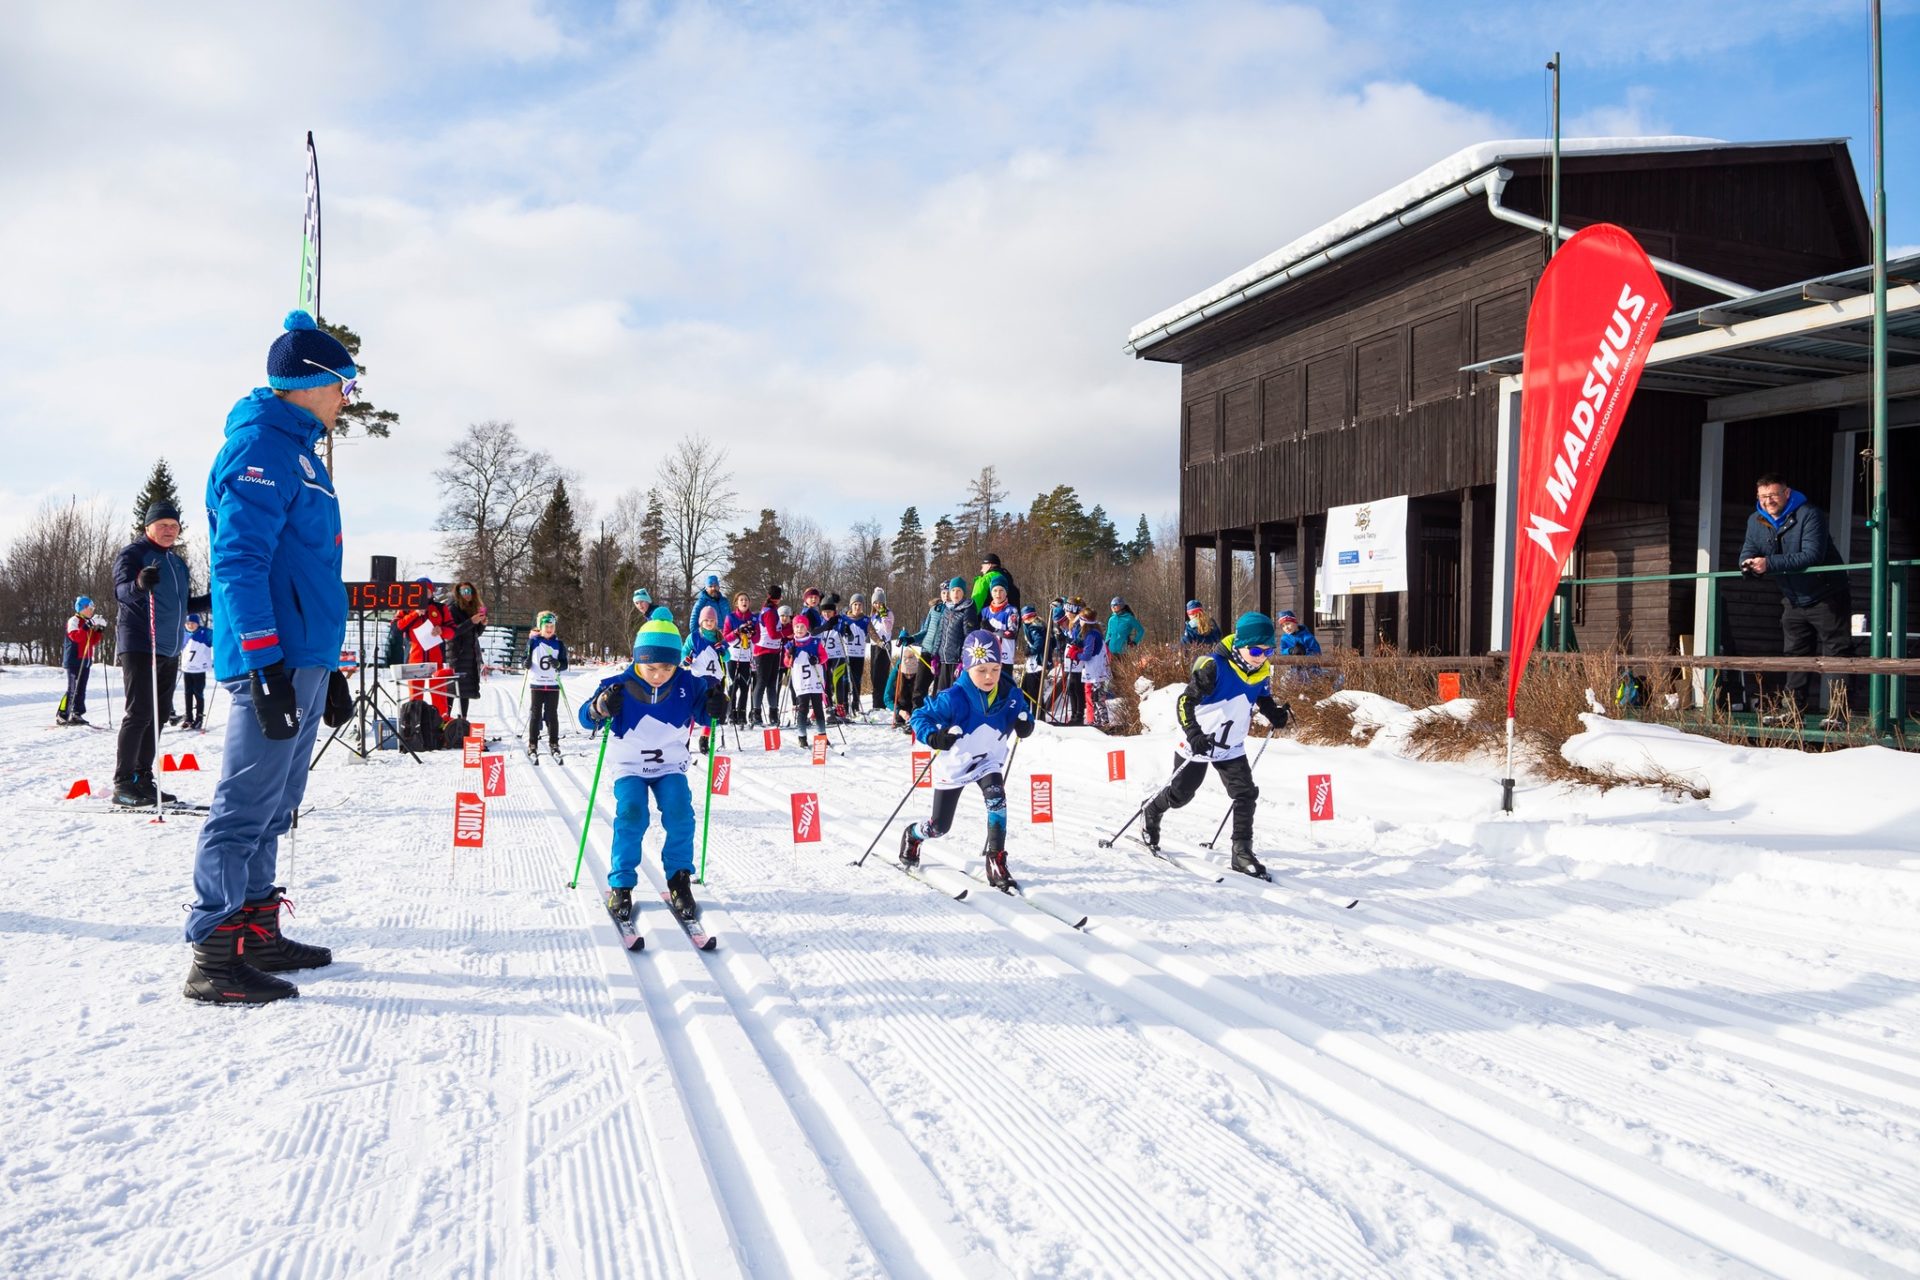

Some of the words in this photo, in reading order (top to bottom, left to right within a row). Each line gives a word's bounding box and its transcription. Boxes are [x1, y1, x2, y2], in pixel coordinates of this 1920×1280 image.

[1585, 451, 1596, 467] THE
[1592, 425, 1606, 451] CROSS
[1602, 387, 1620, 425] COUNTRY
[1618, 345, 1636, 386] COMPANY
[1635, 321, 1648, 345] SINCE
[1645, 302, 1658, 320] 1906
[1545, 284, 1645, 515] MADSHUS
[237, 474, 275, 487] SLOVAKIA
[189, 650, 197, 662] 7
[540, 655, 553, 671] 6
[706, 660, 717, 674] 4
[801, 664, 812, 680] 5
[679, 688, 686, 698] 3
[1010, 700, 1017, 708] 2
[1212, 720, 1235, 750] 1
[465, 742, 481, 764] SWIX
[640, 749, 665, 764] 3
[815, 739, 826, 761] SWIX
[914, 757, 931, 784] SWIX
[1032, 781, 1051, 815] SWIX
[457, 802, 484, 840] SWIX
